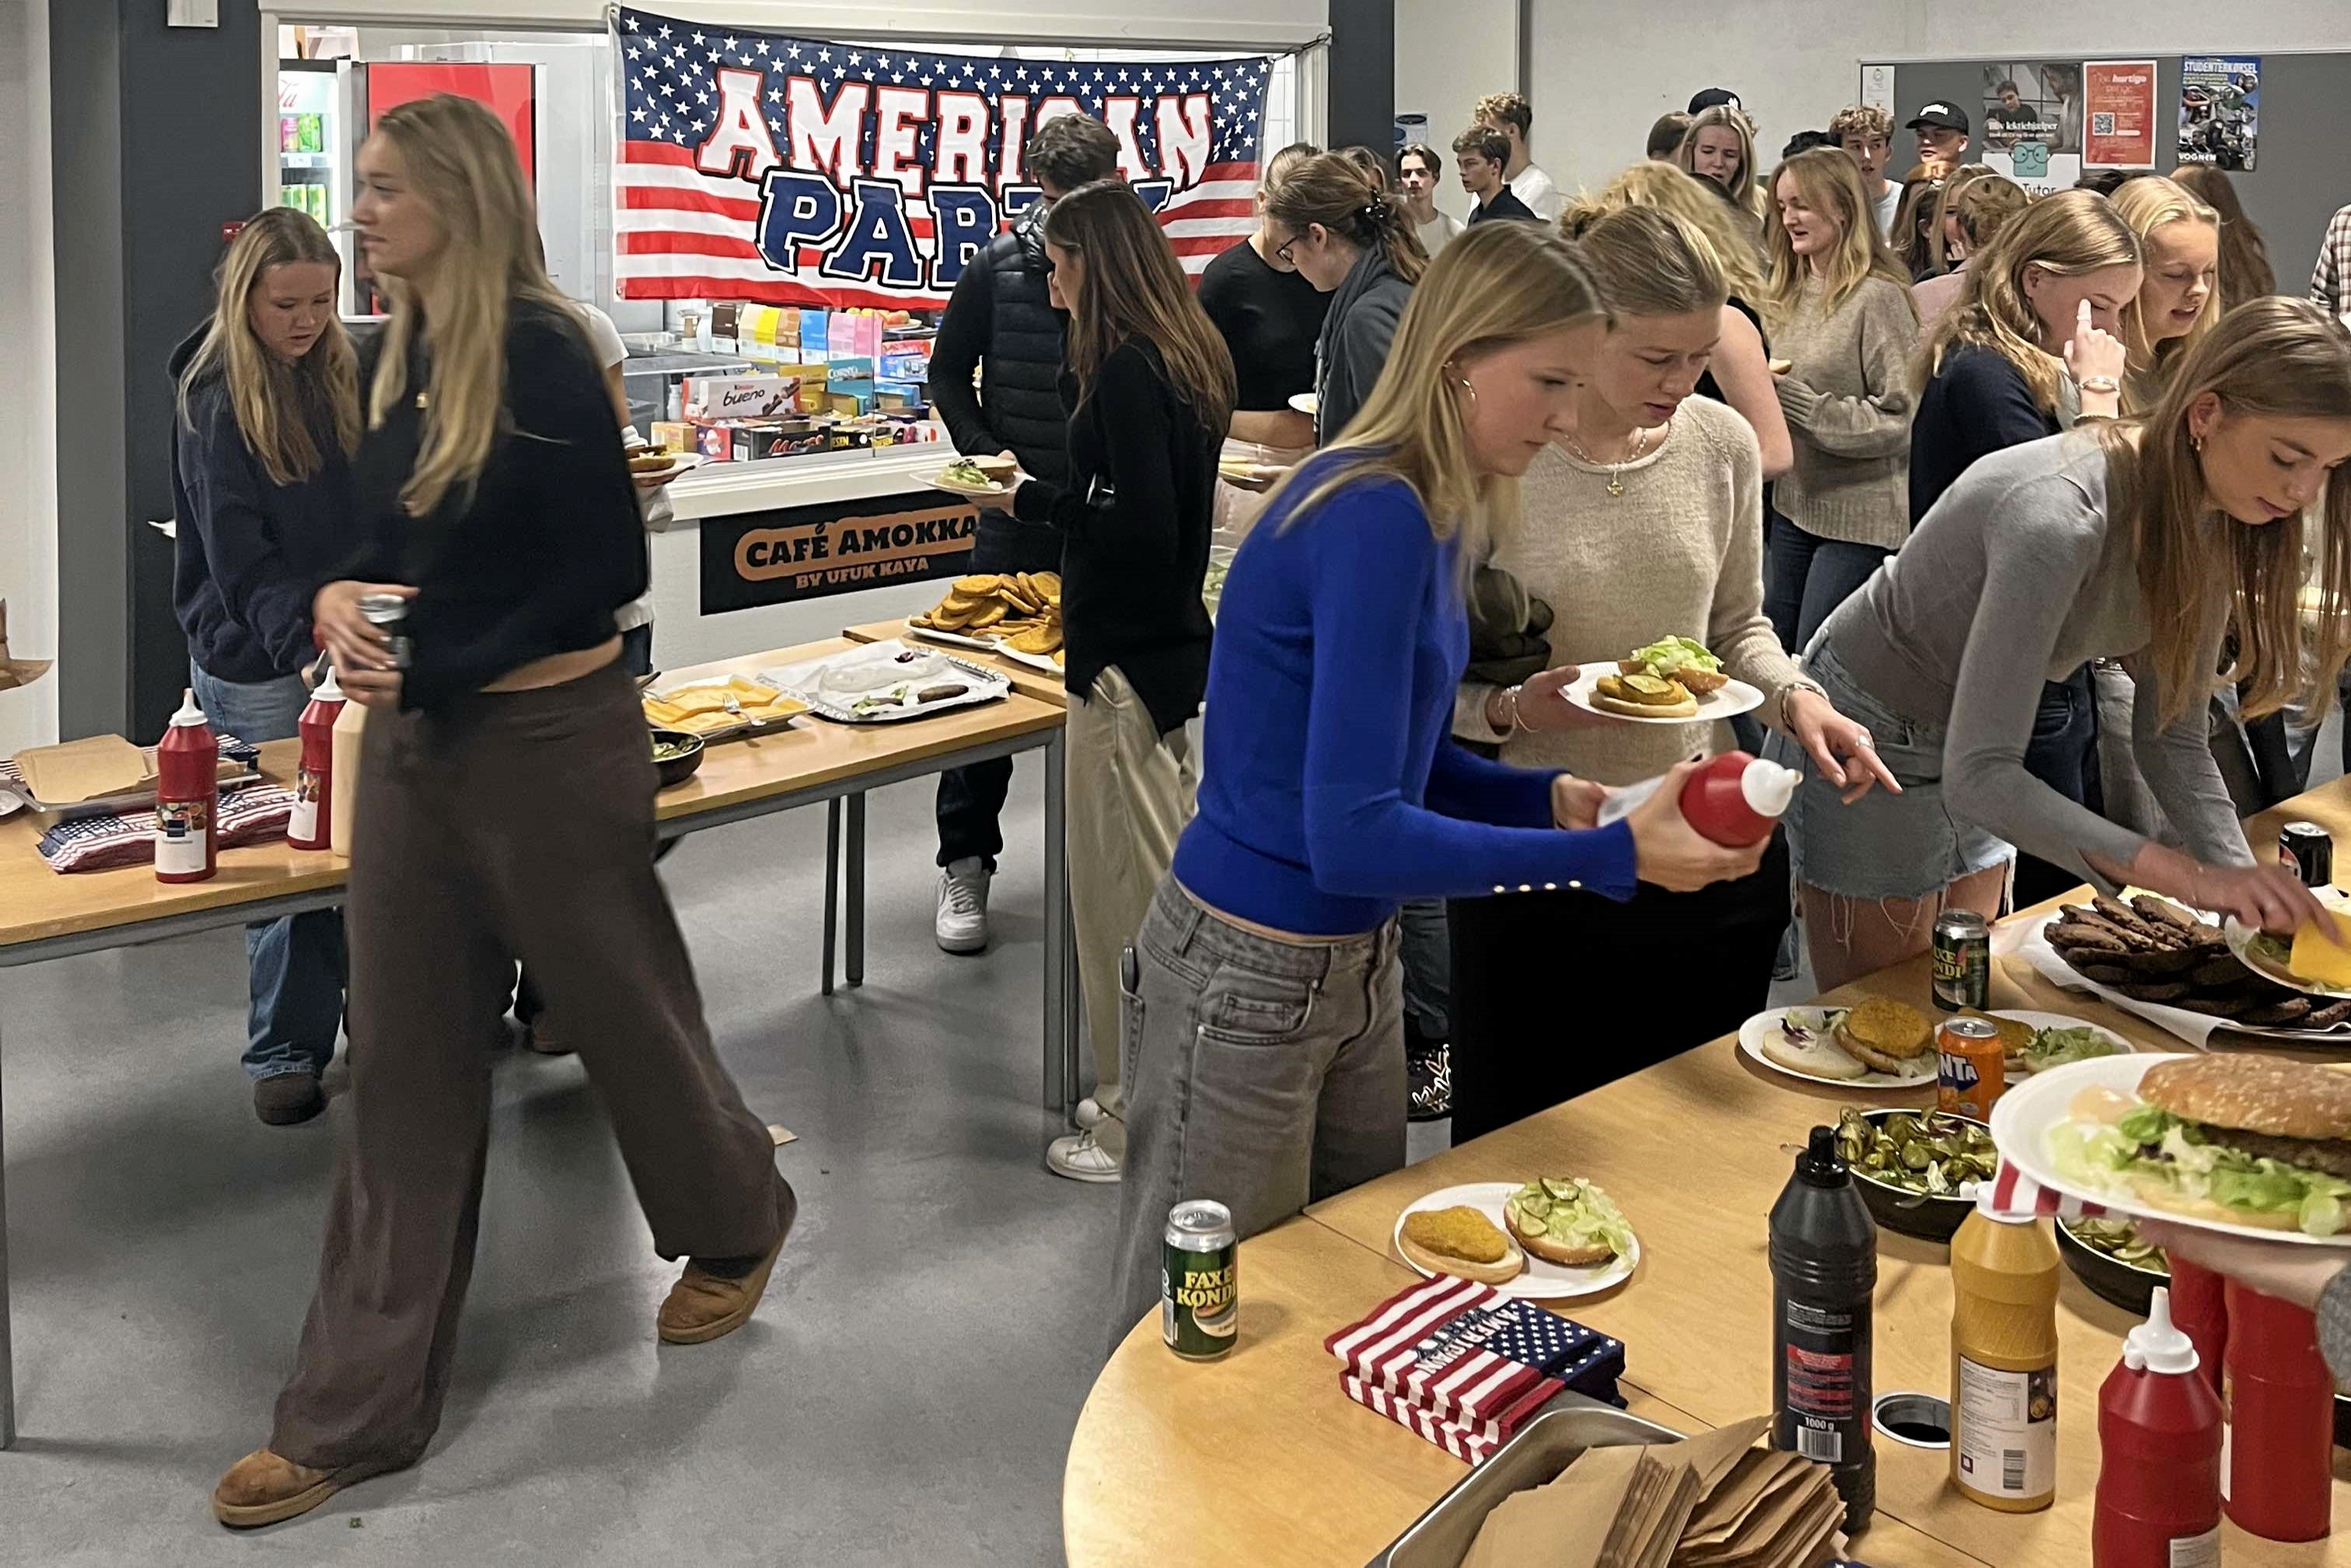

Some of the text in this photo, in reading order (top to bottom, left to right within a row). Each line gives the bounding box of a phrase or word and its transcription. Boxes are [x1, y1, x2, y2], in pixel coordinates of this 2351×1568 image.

[756, 167, 1175, 291] PAR
[723, 389, 765, 407] bueno
[746, 515, 977, 567] CAFÉ AMOKKA
[795, 557, 929, 589] BY UFUK KAYA
[1940, 1053, 1978, 1081] NTA
[1184, 1264, 1233, 1289] FAXE
[1805, 1417, 1835, 1432] 1000 g
